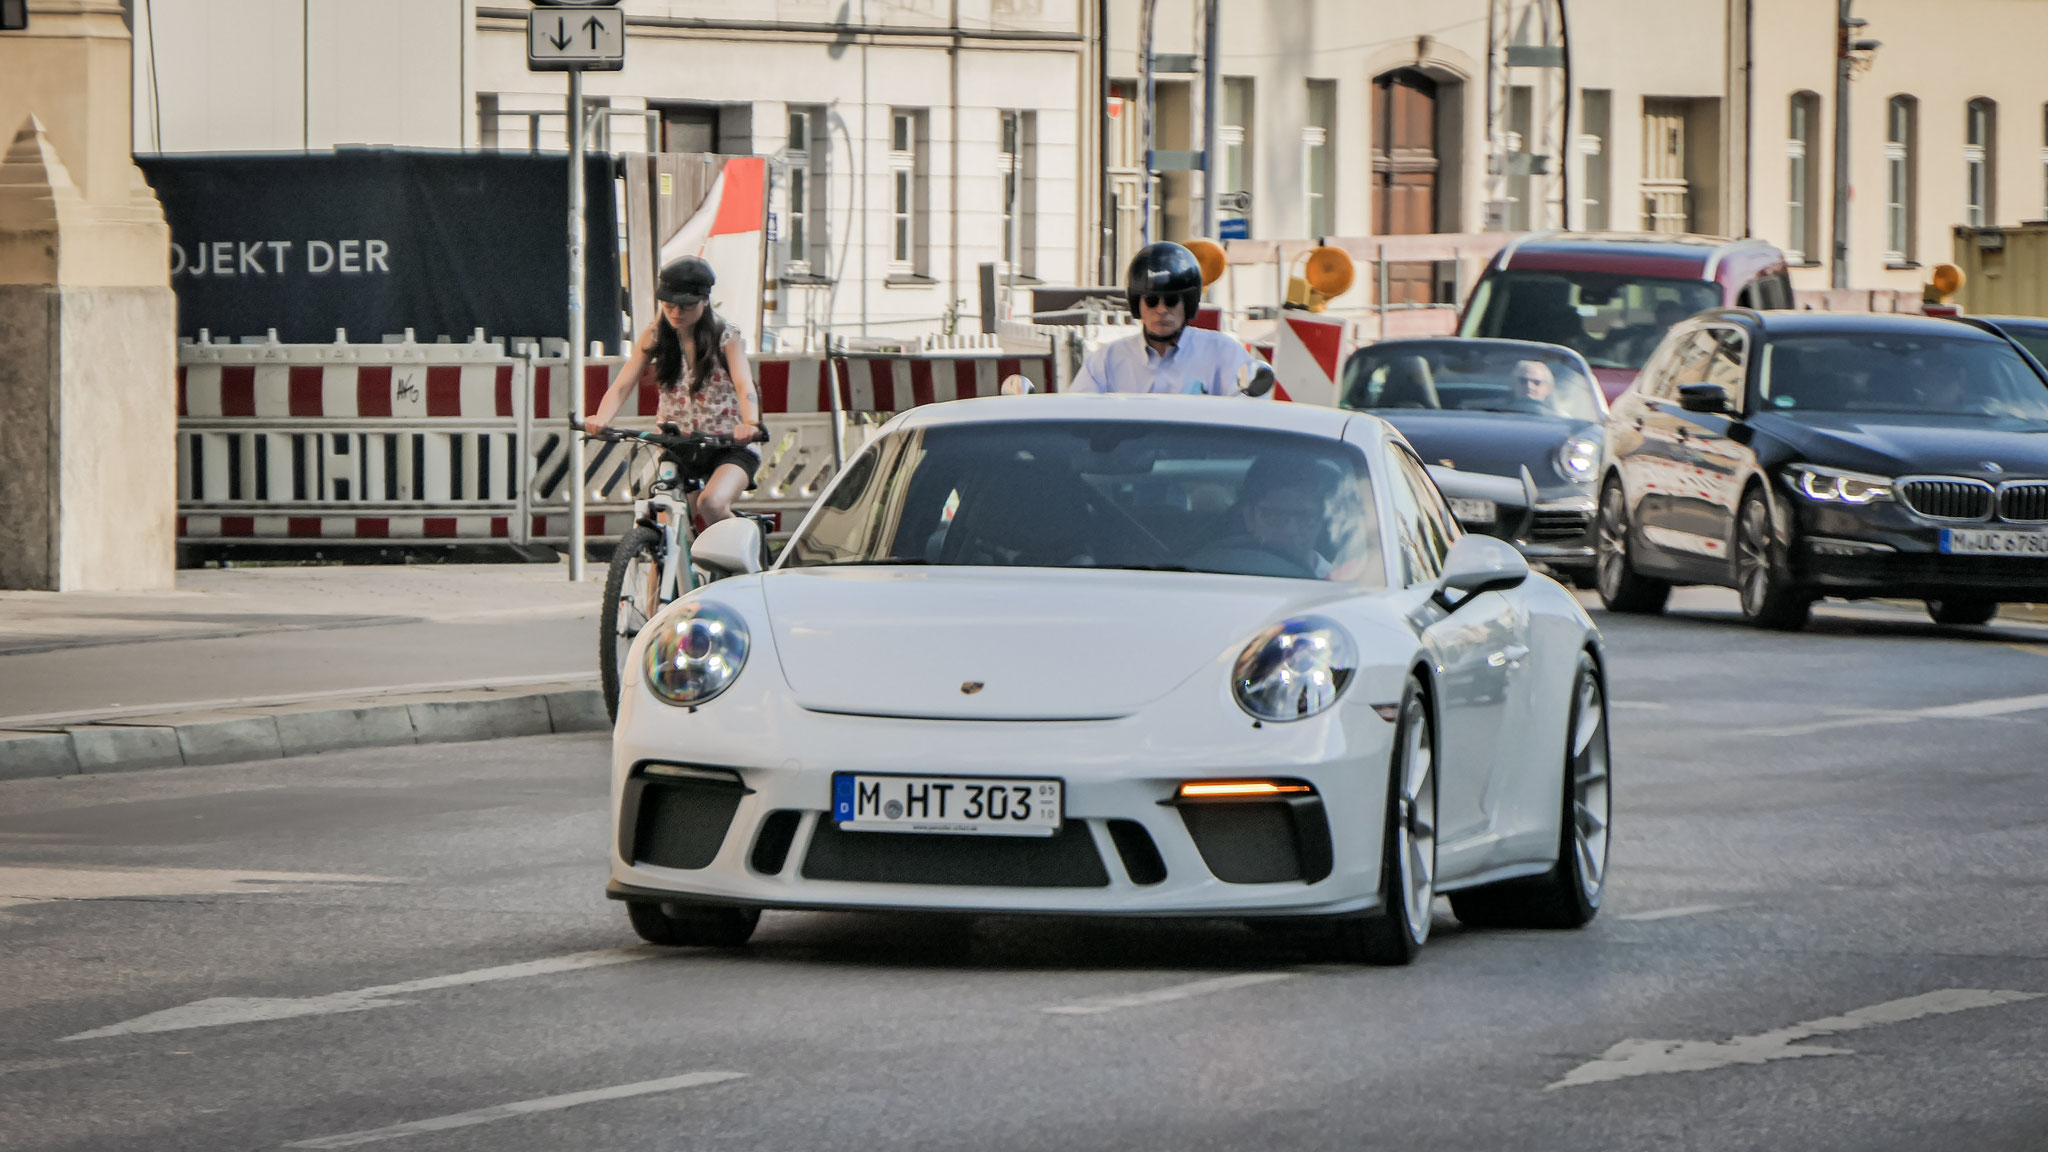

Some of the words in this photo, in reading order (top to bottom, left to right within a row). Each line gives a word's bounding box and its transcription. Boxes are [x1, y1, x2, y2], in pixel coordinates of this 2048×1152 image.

[307, 239, 389, 274] DER
[858, 781, 881, 816] M
[907, 783, 955, 818] HT
[963, 785, 1033, 821] 303
